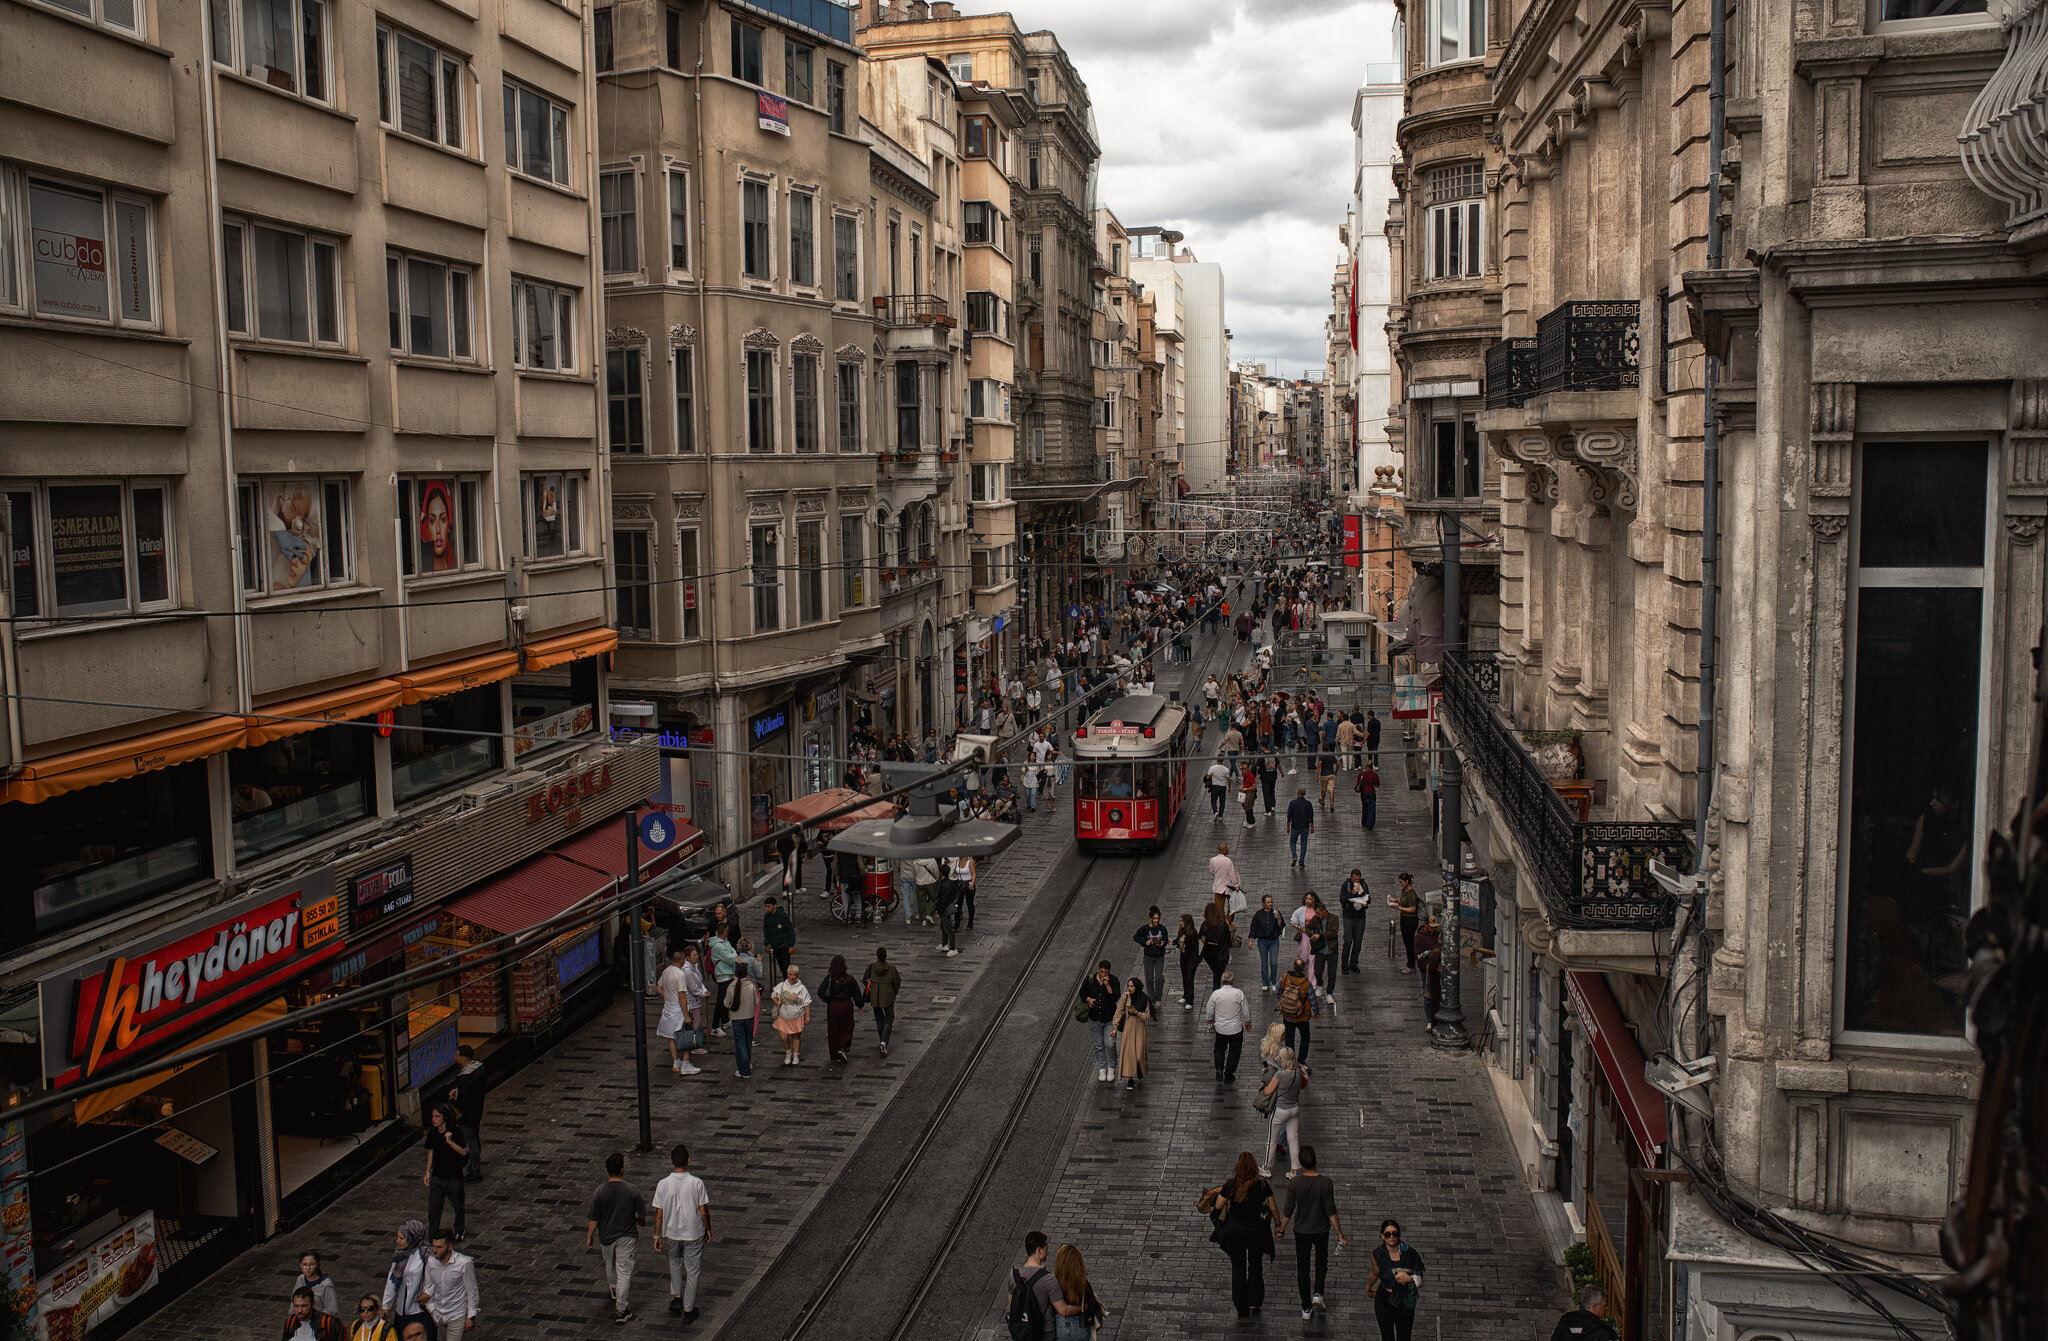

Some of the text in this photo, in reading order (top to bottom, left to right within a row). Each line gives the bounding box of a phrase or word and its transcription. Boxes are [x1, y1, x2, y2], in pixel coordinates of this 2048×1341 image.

[38, 237, 102, 265] cubdo
[66, 266, 105, 282] ACADEMY
[52, 516, 121, 536] ESMERALDA
[526, 762, 613, 823] KOSKA
[305, 900, 335, 922] 955 50 20
[383, 900, 395, 914] BAG
[395, 893, 413, 908] STORE
[140, 910, 299, 1014] heydöner
